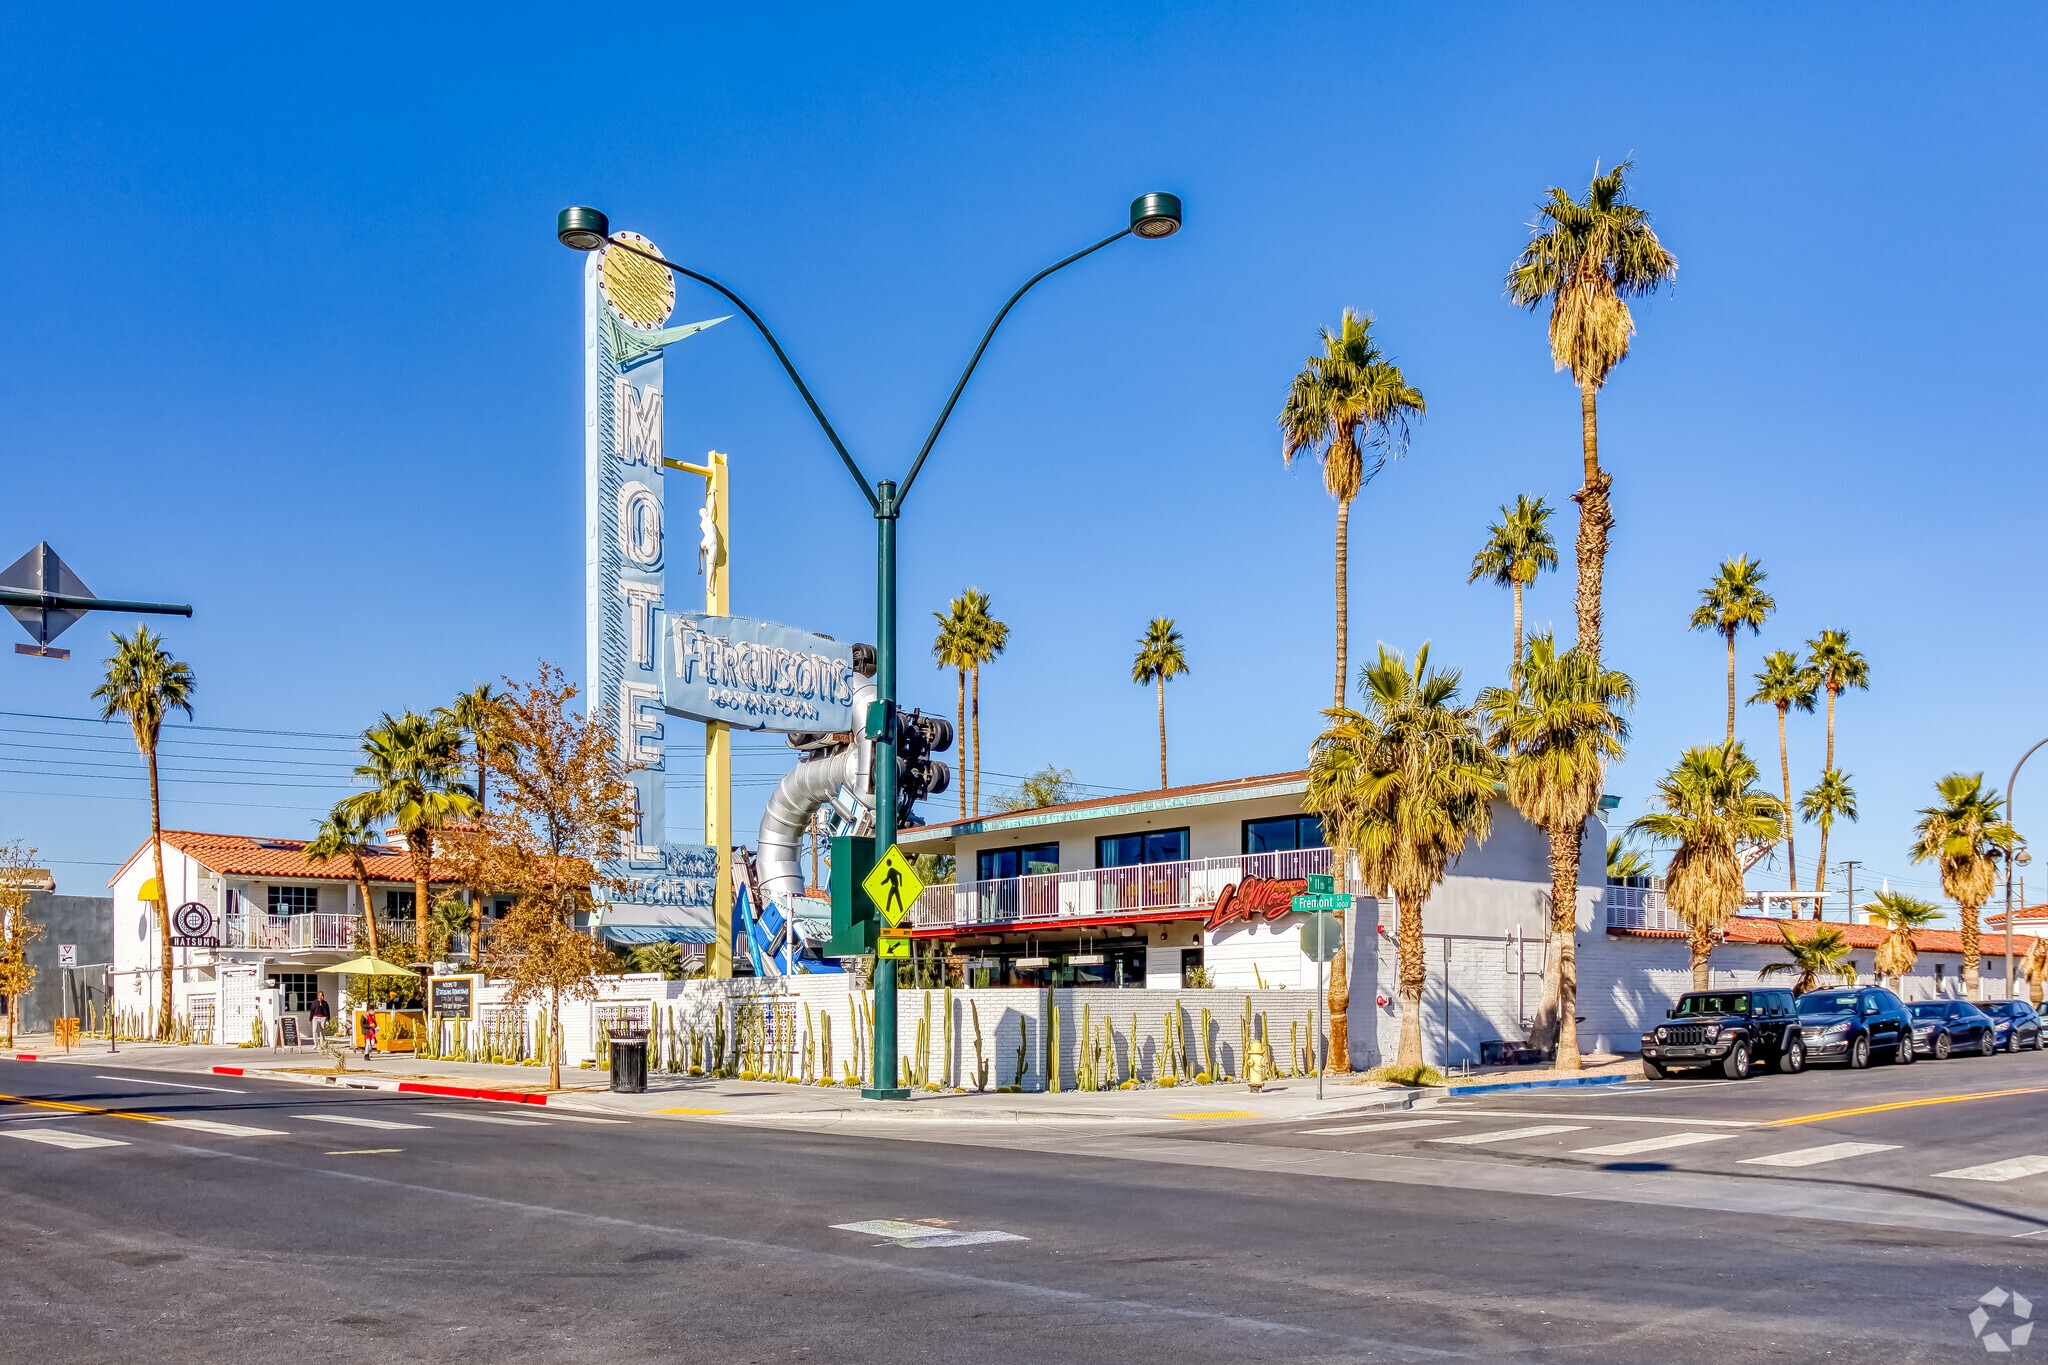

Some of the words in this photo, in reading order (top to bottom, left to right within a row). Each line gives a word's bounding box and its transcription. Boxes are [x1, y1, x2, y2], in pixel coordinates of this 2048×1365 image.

[614, 374, 663, 862] MOTEL
[708, 687, 816, 718] DOWNTOWN
[1299, 896, 1333, 909] Fremont
[174, 937, 214, 947] HATSUMI
